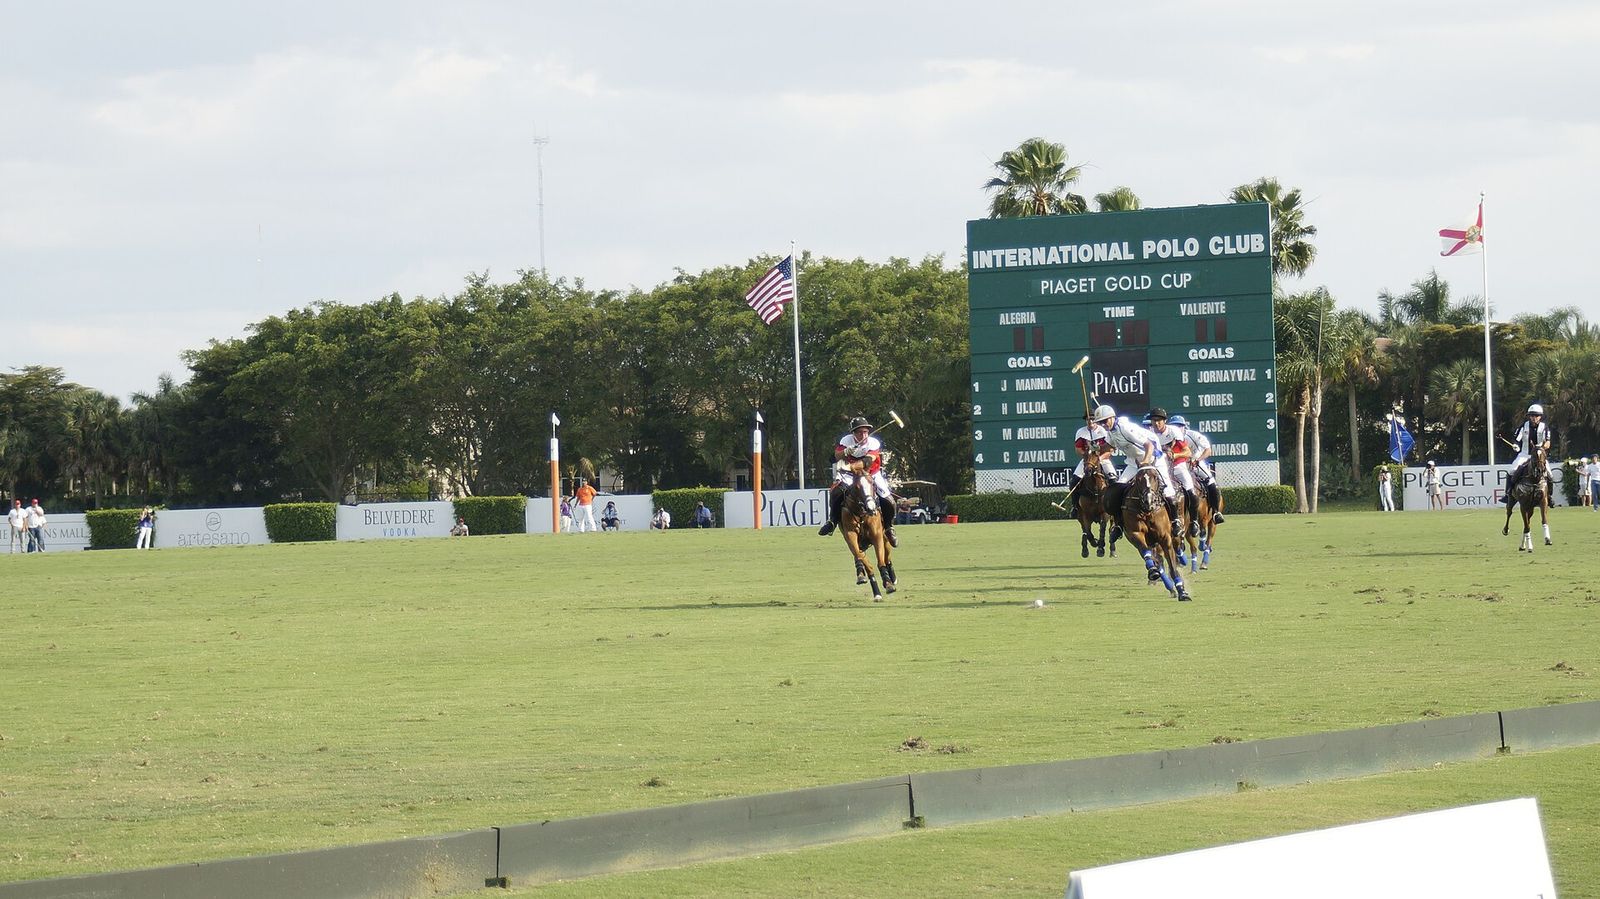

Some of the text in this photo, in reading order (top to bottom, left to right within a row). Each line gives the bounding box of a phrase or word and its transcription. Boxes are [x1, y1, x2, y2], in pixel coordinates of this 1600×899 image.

[973, 234, 1265, 269] INTERNATIONAL POLO CLUB
[1040, 272, 1192, 295] PIAGET GOLD CUP
[1103, 306, 1135, 318] TIME
[1180, 301, 1226, 316] VALIENTE
[999, 311, 1036, 326] ALEGRIA
[1188, 347, 1235, 360] GOALS
[1007, 355, 1052, 369] GOALS
[1182, 368, 1272, 384] B JORNAYVAZ 1
[974, 376, 1053, 392] 1 J MANNIX
[973, 400, 1048, 416] 2 H ULLOA
[1182, 393, 1274, 408] S TORRES 2
[974, 426, 1057, 440] 3 M AGUERRE
[1199, 420, 1229, 434] CASET
[1266, 418, 1275, 430] 3
[974, 453, 984, 464] 4
[1017, 449, 1066, 464] ZAVALETA
[1211, 442, 1276, 457] MBIASO 4
[1404, 468, 1563, 488] PIGET PO
[364, 508, 436, 526] BELVEDERE
[60, 528, 85, 538] MALL
[178, 531, 250, 546] artesano
